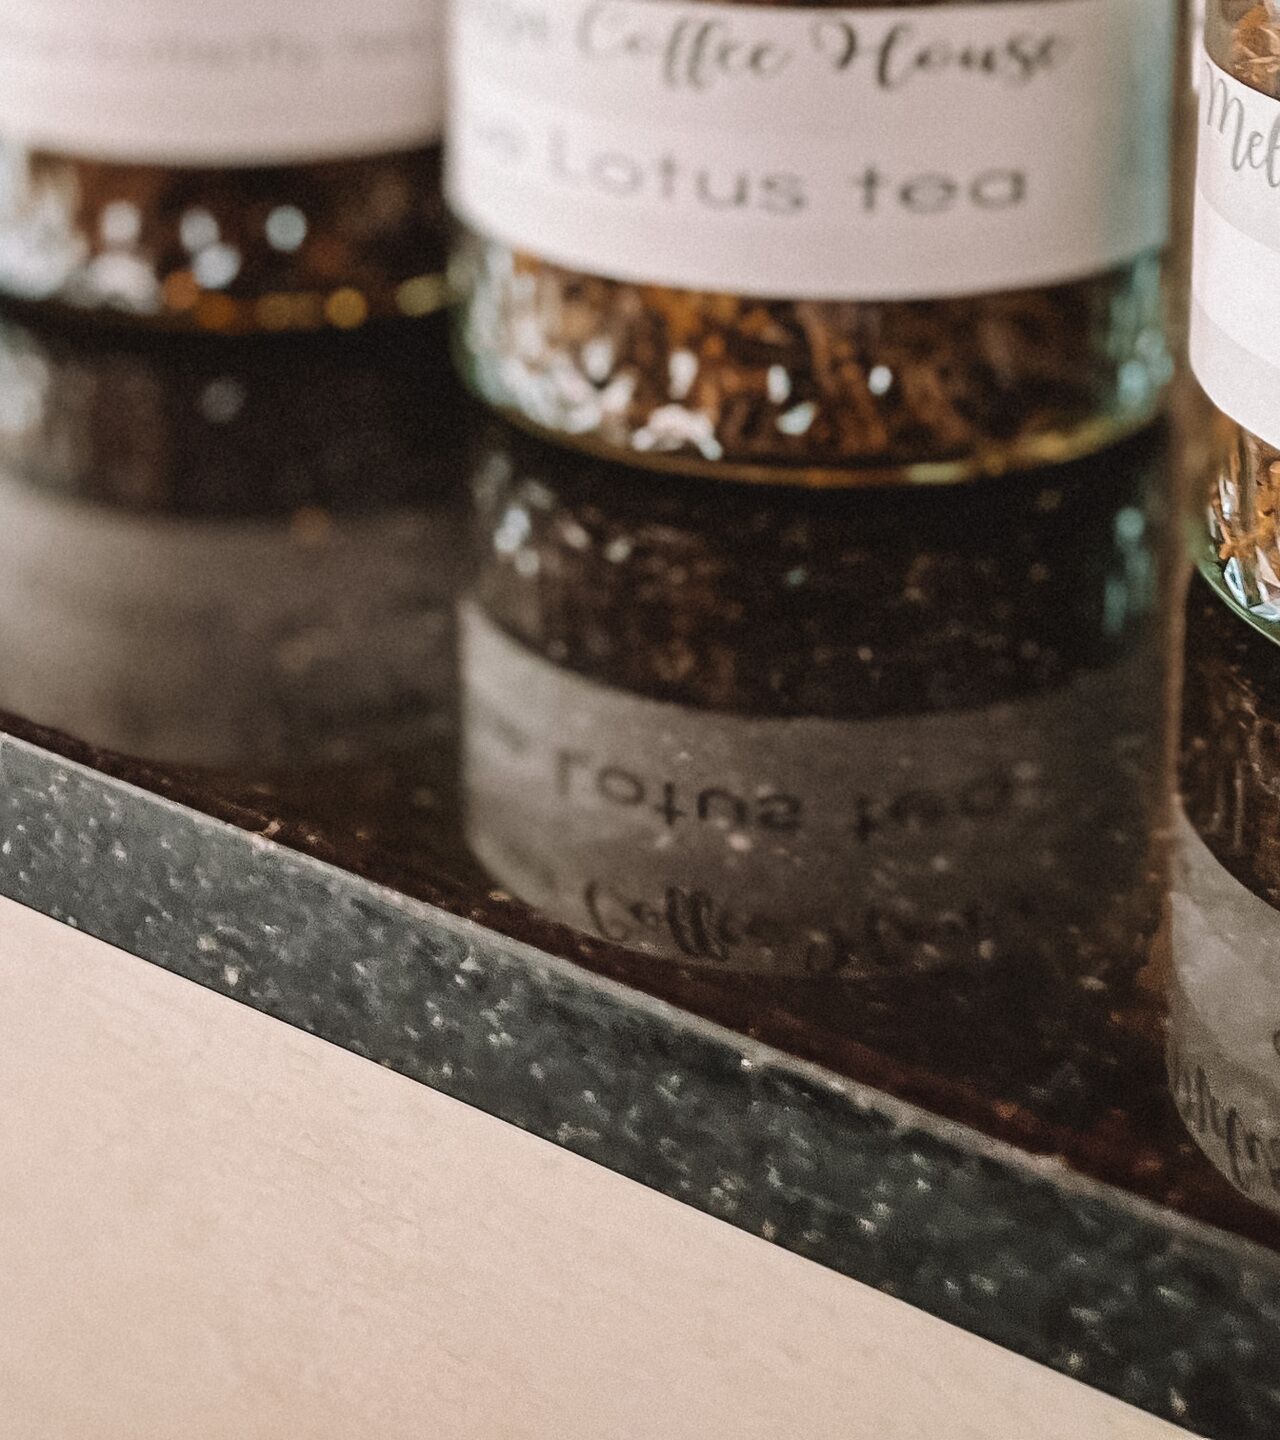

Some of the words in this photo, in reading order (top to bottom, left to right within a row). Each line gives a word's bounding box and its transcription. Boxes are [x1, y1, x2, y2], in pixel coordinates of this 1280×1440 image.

[808, 16, 1072, 92] House
[546, 124, 810, 216] Lotus
[850, 161, 1029, 216] tea
